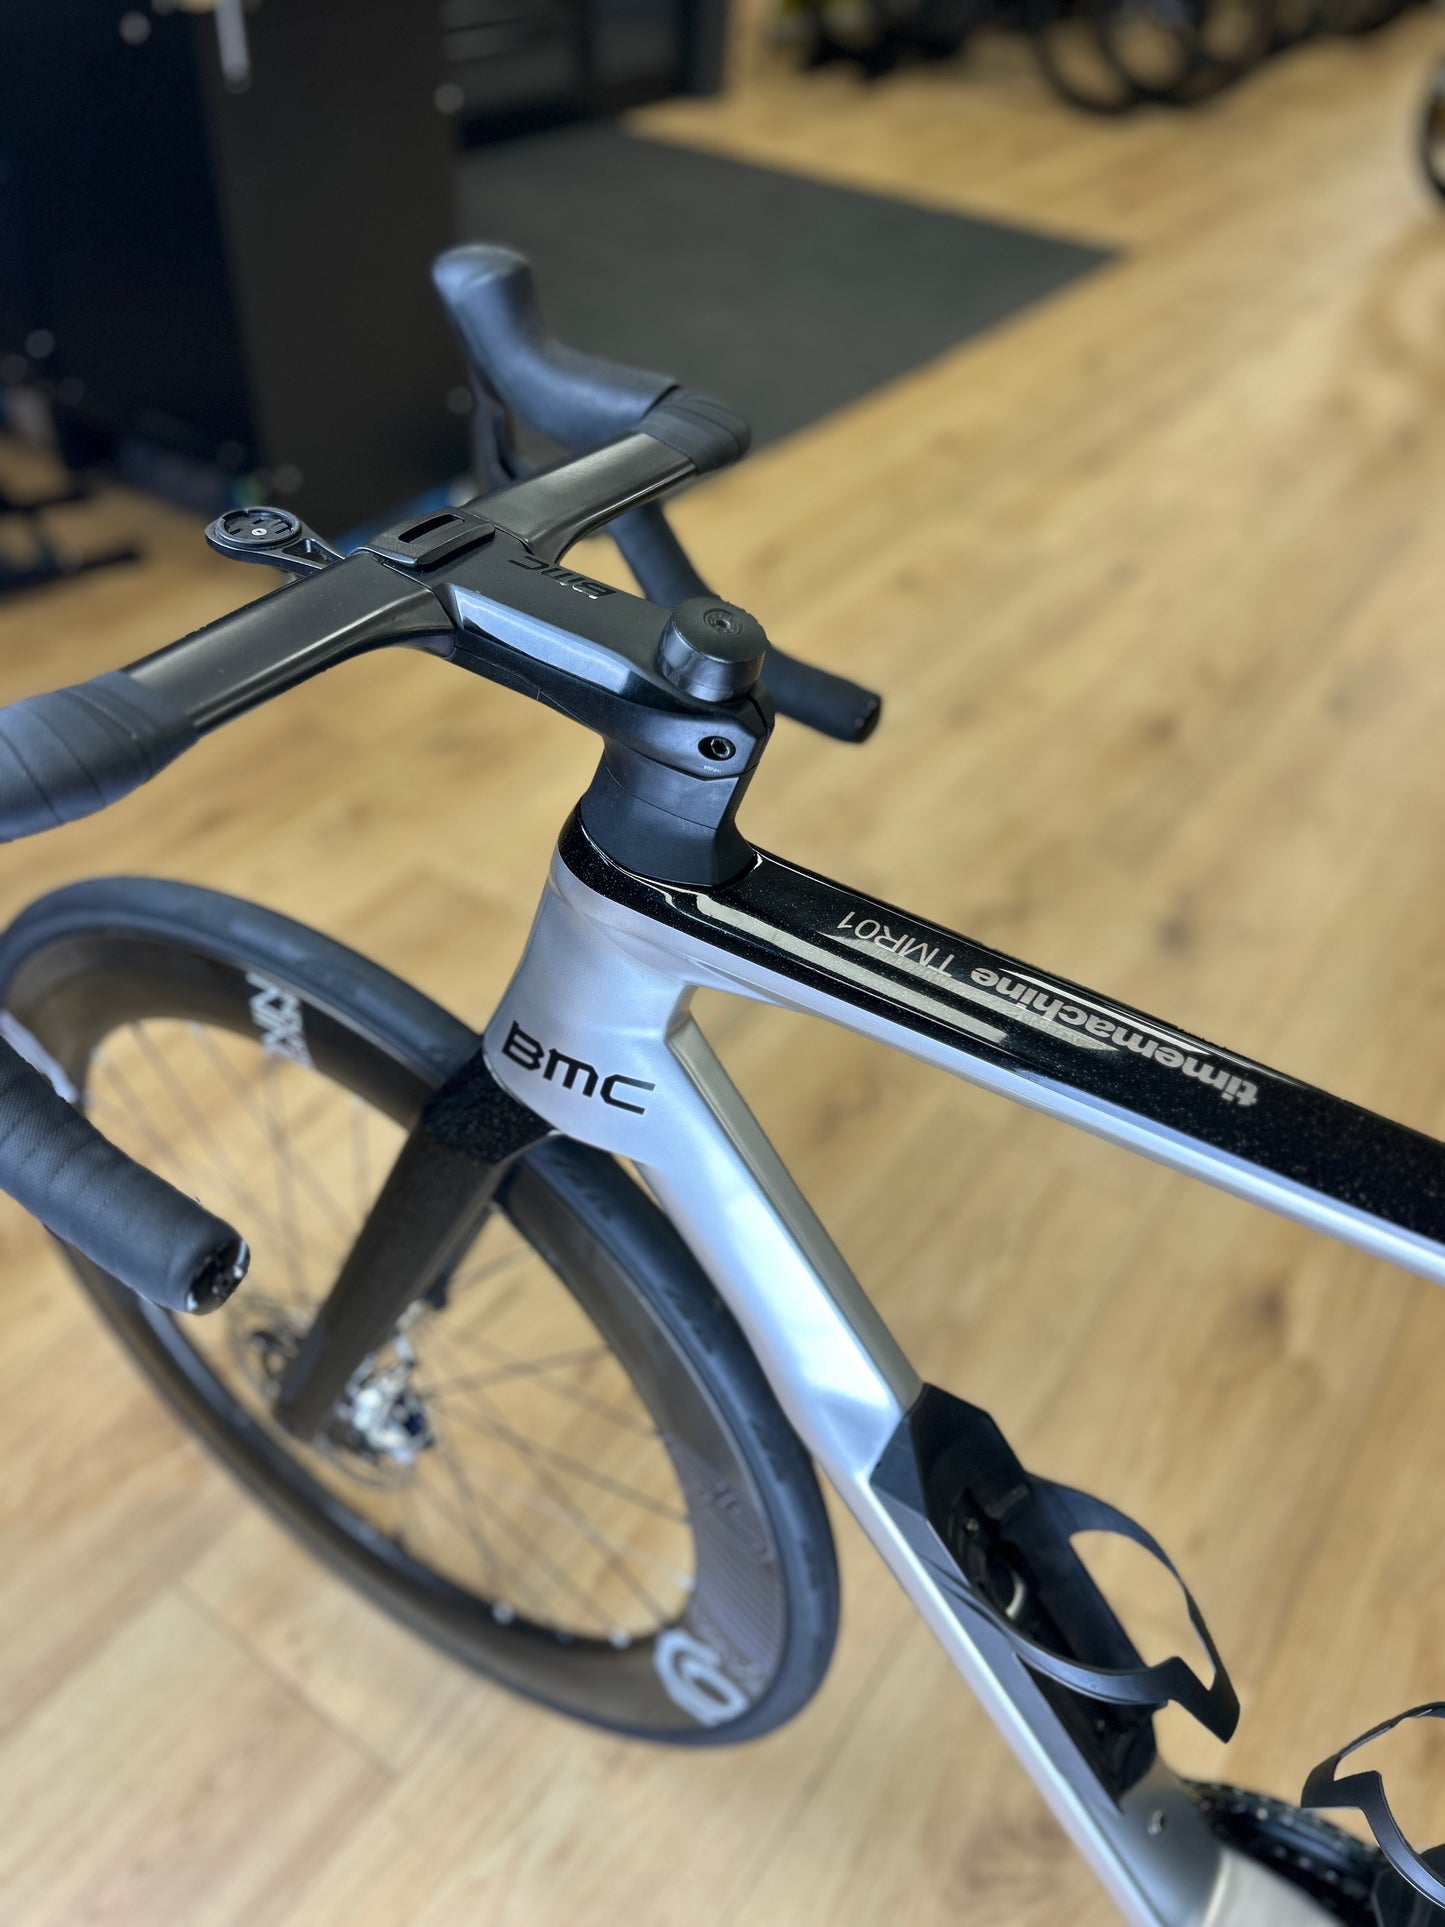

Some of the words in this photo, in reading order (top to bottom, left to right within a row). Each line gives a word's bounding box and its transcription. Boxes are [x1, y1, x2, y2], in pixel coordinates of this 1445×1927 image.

[506, 555, 617, 600] BMC
[836, 910, 955, 977] TMR01
[501, 1020, 656, 1116] BMC
[970, 966, 1258, 1107] timemachine
